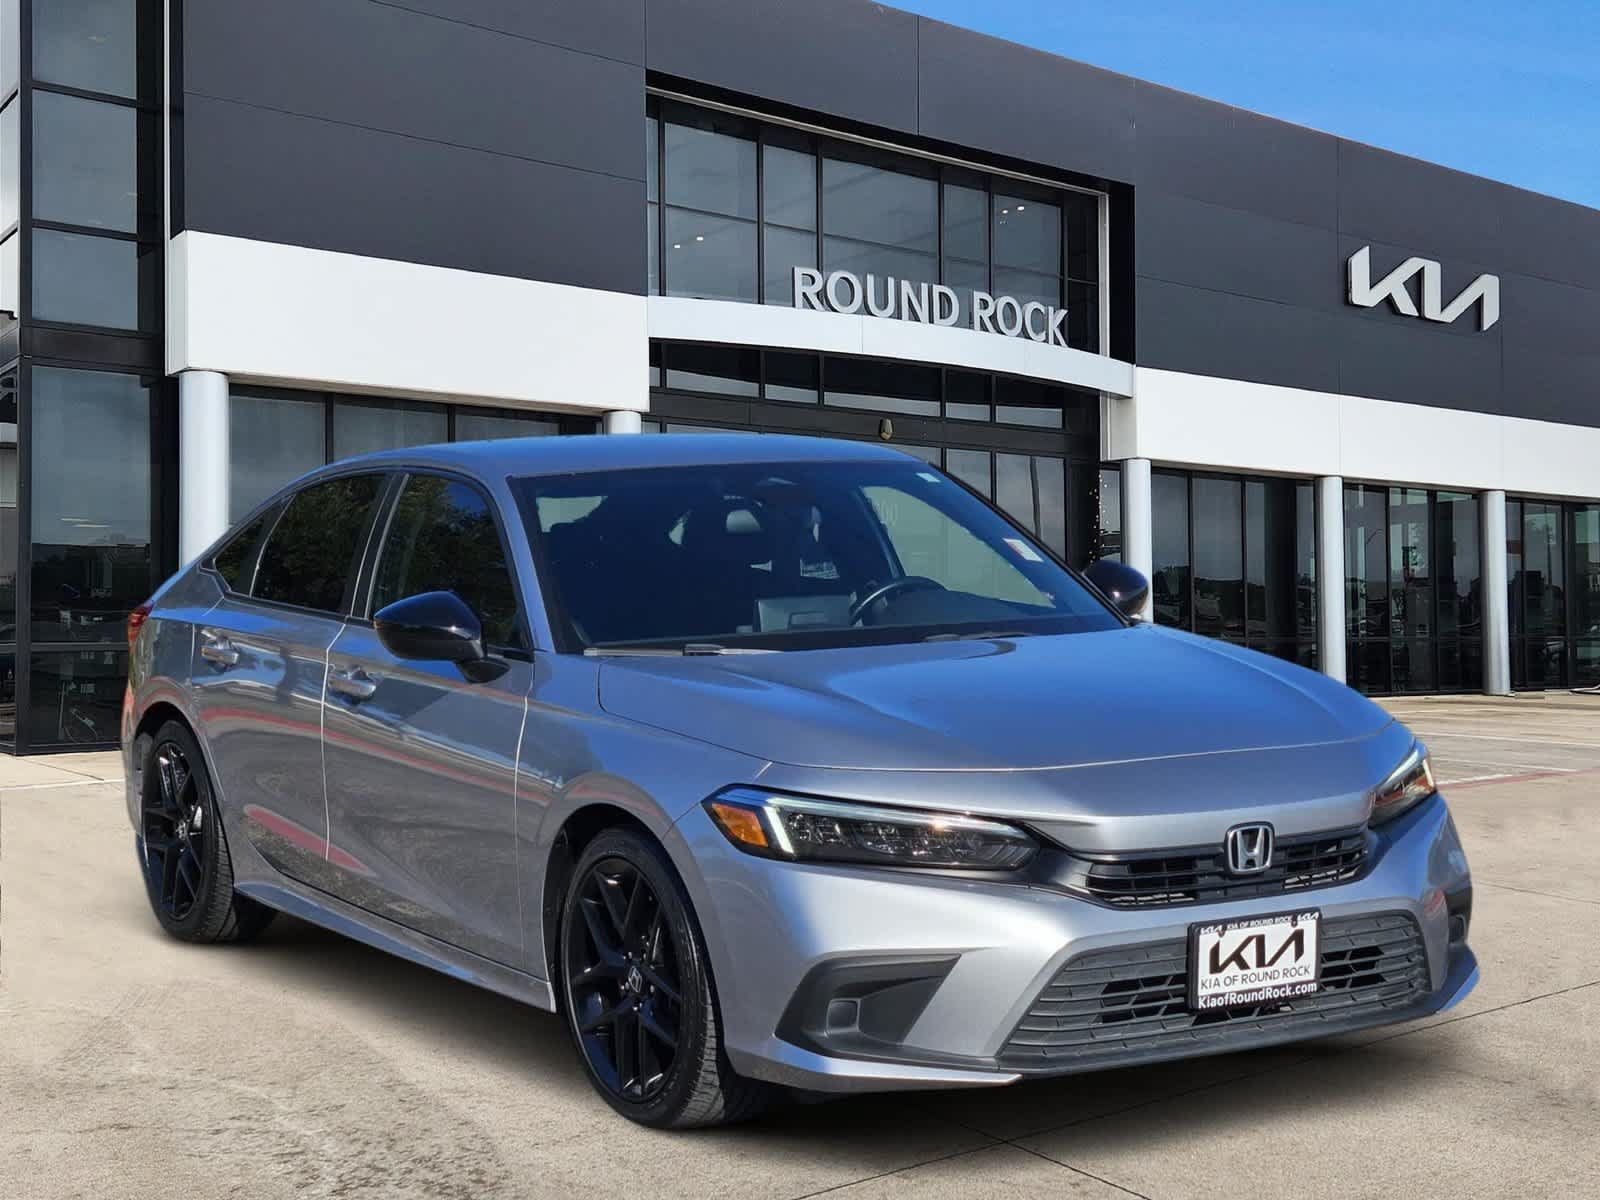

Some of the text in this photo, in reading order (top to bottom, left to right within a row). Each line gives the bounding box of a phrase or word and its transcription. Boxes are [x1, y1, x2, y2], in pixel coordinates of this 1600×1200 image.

[792, 266, 1069, 348] ROUND ROCK
[1201, 963, 1311, 991] KIA OF ROUND ROCK
[1198, 982, 1318, 1010] KiaofRoundRock.com
